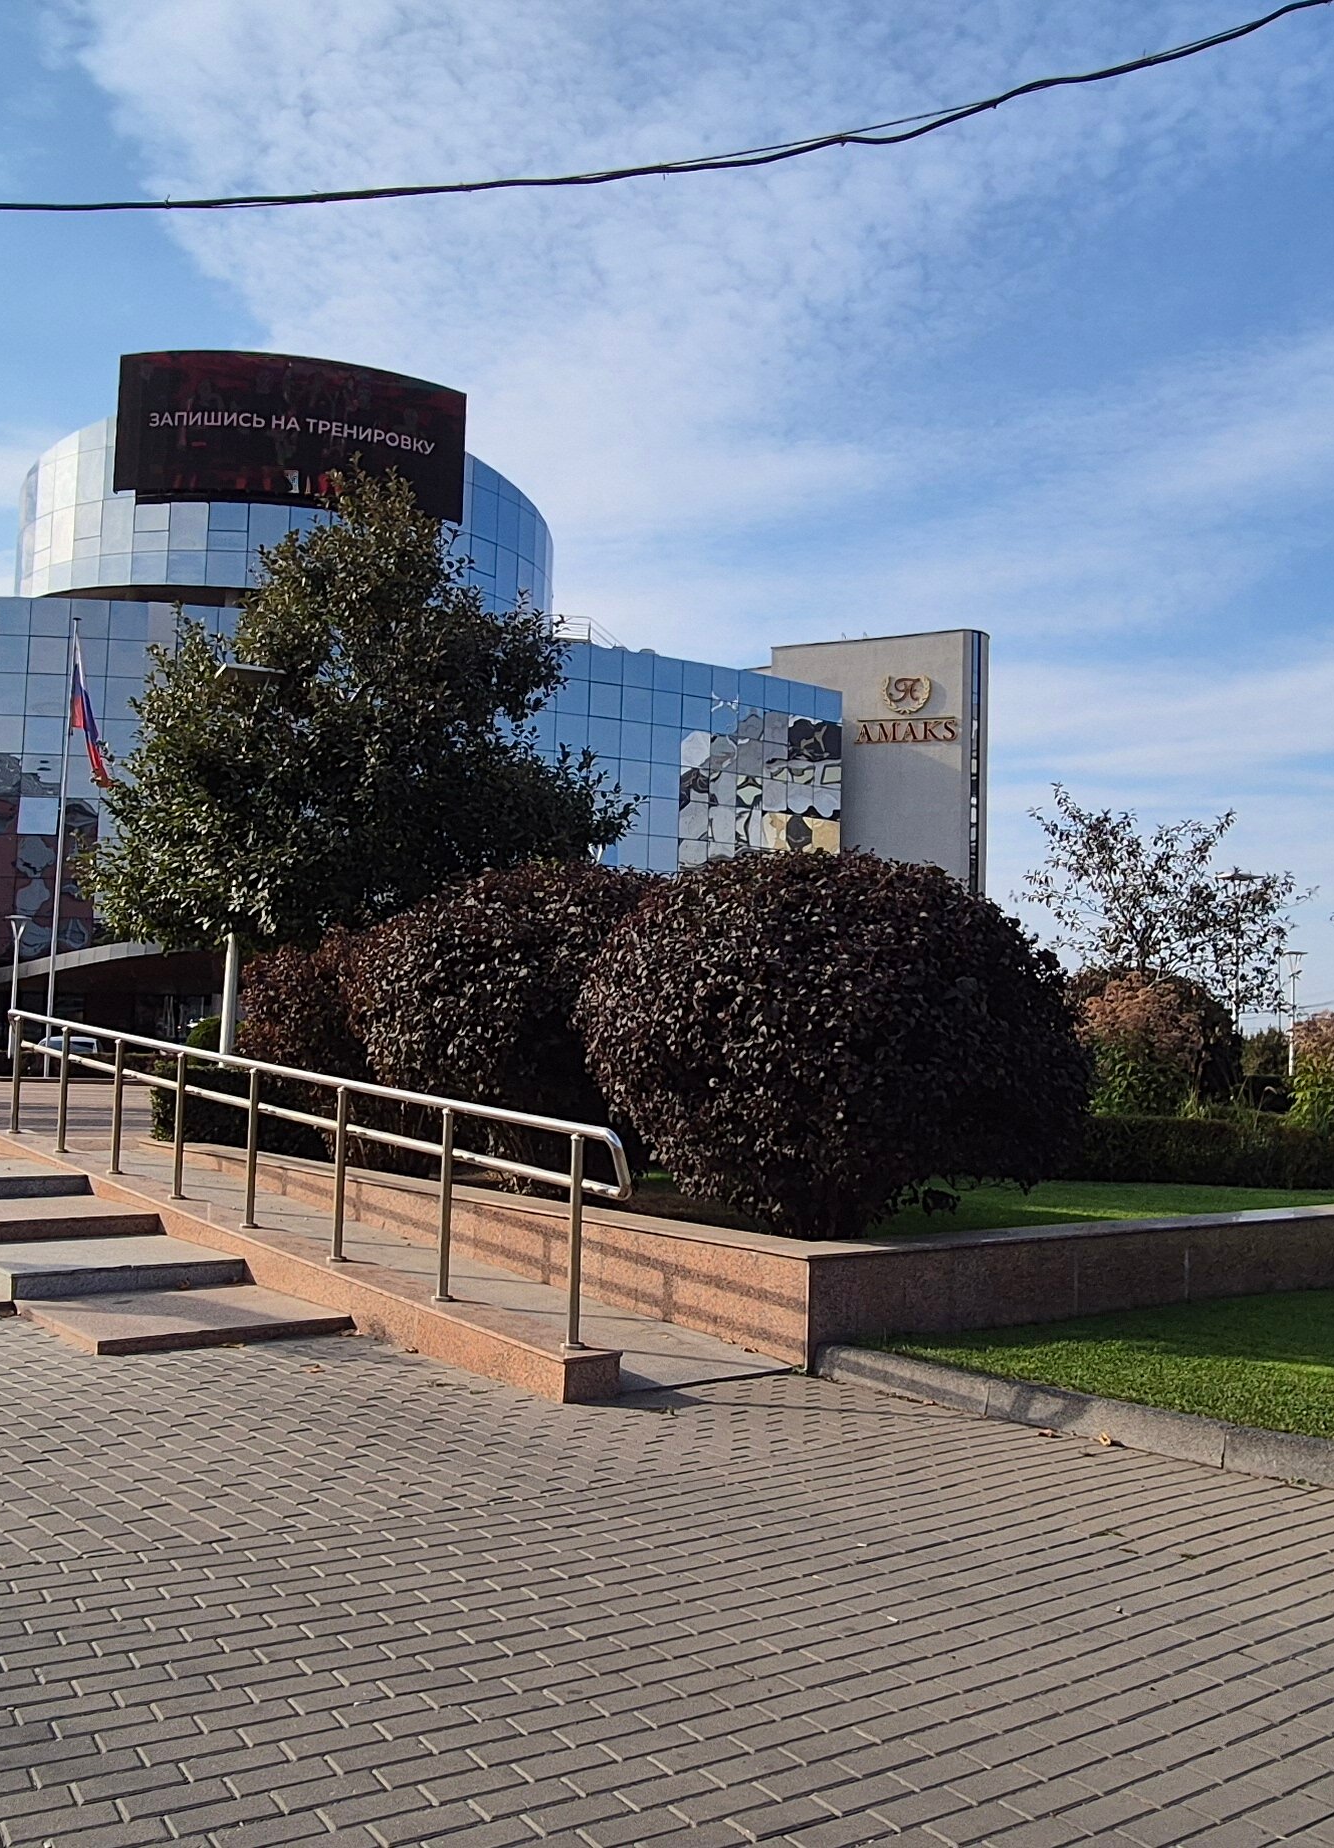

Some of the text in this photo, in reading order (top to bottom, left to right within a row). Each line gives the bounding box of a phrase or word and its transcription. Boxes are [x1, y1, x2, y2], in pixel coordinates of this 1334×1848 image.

[149, 411, 436, 456] ЗАПИШИСЬ НА ТРЕНИРОВКУ
[855, 719, 958, 744] AMAKS
